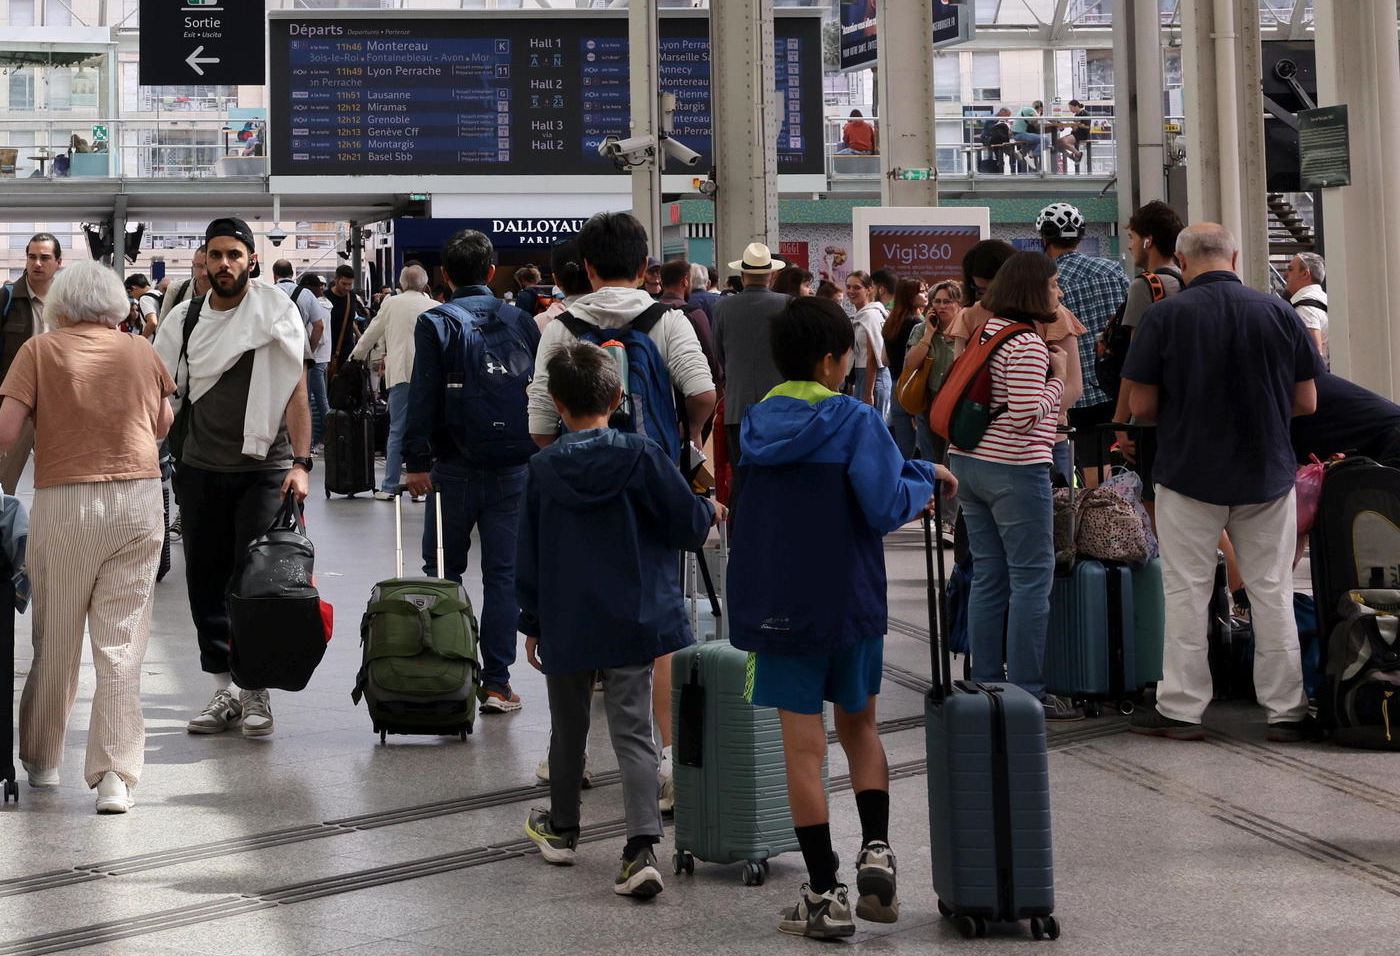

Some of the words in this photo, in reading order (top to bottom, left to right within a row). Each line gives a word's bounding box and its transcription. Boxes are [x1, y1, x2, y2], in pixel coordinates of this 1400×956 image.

[184, 17, 221, 28] Sortie
[289, 24, 343, 38] Départs
[336, 43, 362, 51] 11h46
[367, 41, 428, 51] Montereau
[499, 42, 505, 50] K
[530, 38, 552, 48] Hall
[556, 38, 562, 48] 1
[366, 53, 432, 62] Fontainebleau
[441, 53, 464, 62] Avon
[659, 52, 700, 61] Marseille
[531, 58, 538, 66] A
[554, 58, 561, 66] N
[336, 68, 362, 76] 11h49
[367, 66, 392, 77] Lyon
[395, 66, 441, 76] Perrache
[497, 67, 508, 75] 11
[659, 65, 692, 75] Annecy
[322, 78, 362, 87] Perrache
[530, 80, 552, 89] Hall
[556, 80, 563, 89] 2
[659, 77, 709, 86] Montereau
[336, 91, 360, 99] 11h51
[367, 91, 411, 99] Lausanne
[367, 103, 407, 111] Miramas
[532, 99, 538, 107] 5
[553, 99, 564, 107] 23
[336, 116, 361, 124] 12h12
[367, 115, 410, 124] Grenoble
[531, 120, 553, 130] Hall
[557, 120, 564, 130] 3
[337, 128, 361, 136] 12h13
[367, 127, 401, 136] Genève
[404, 127, 419, 136] Cff
[337, 141, 362, 149] 12h16
[368, 140, 414, 150] Montargis
[532, 140, 554, 150] Hall
[557, 140, 564, 150] 2
[337, 153, 361, 161] 12h21
[368, 152, 392, 161] Basel
[395, 152, 413, 161] Sbb
[492, 220, 584, 233] DALLOYAU
[883, 243, 952, 264] Vigi360
